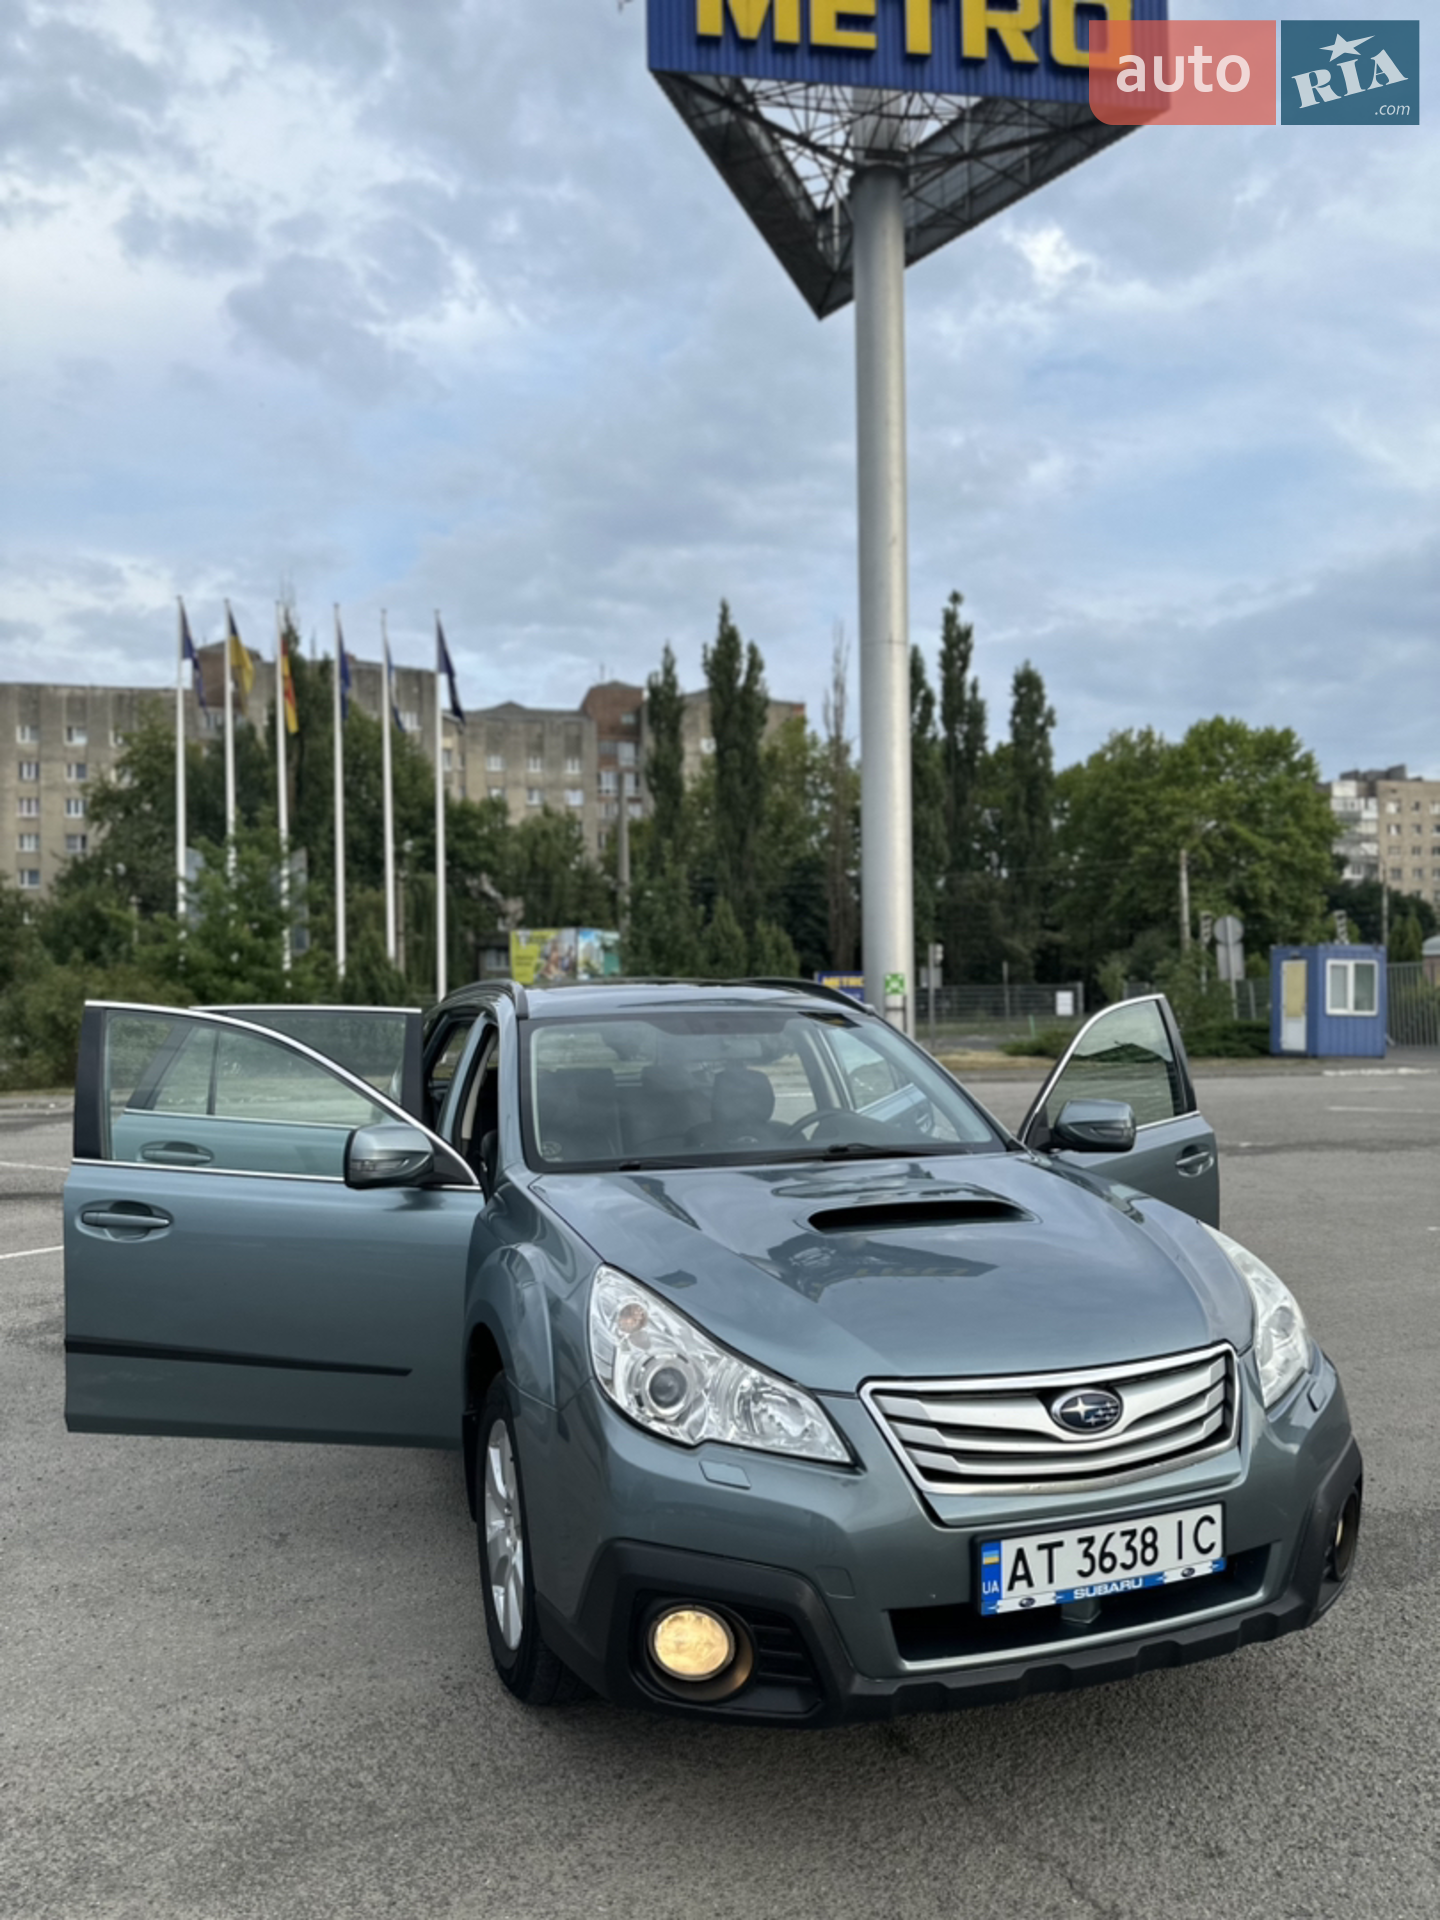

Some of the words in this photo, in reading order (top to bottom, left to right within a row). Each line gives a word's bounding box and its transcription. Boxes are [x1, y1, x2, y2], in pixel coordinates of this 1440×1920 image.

[1007, 1541, 1064, 1591] AT
[1076, 1526, 1159, 1578] 3638
[1177, 1515, 1217, 1560] IC
[982, 1580, 1000, 1595] UA
[1073, 1577, 1143, 1599] SUBARU
